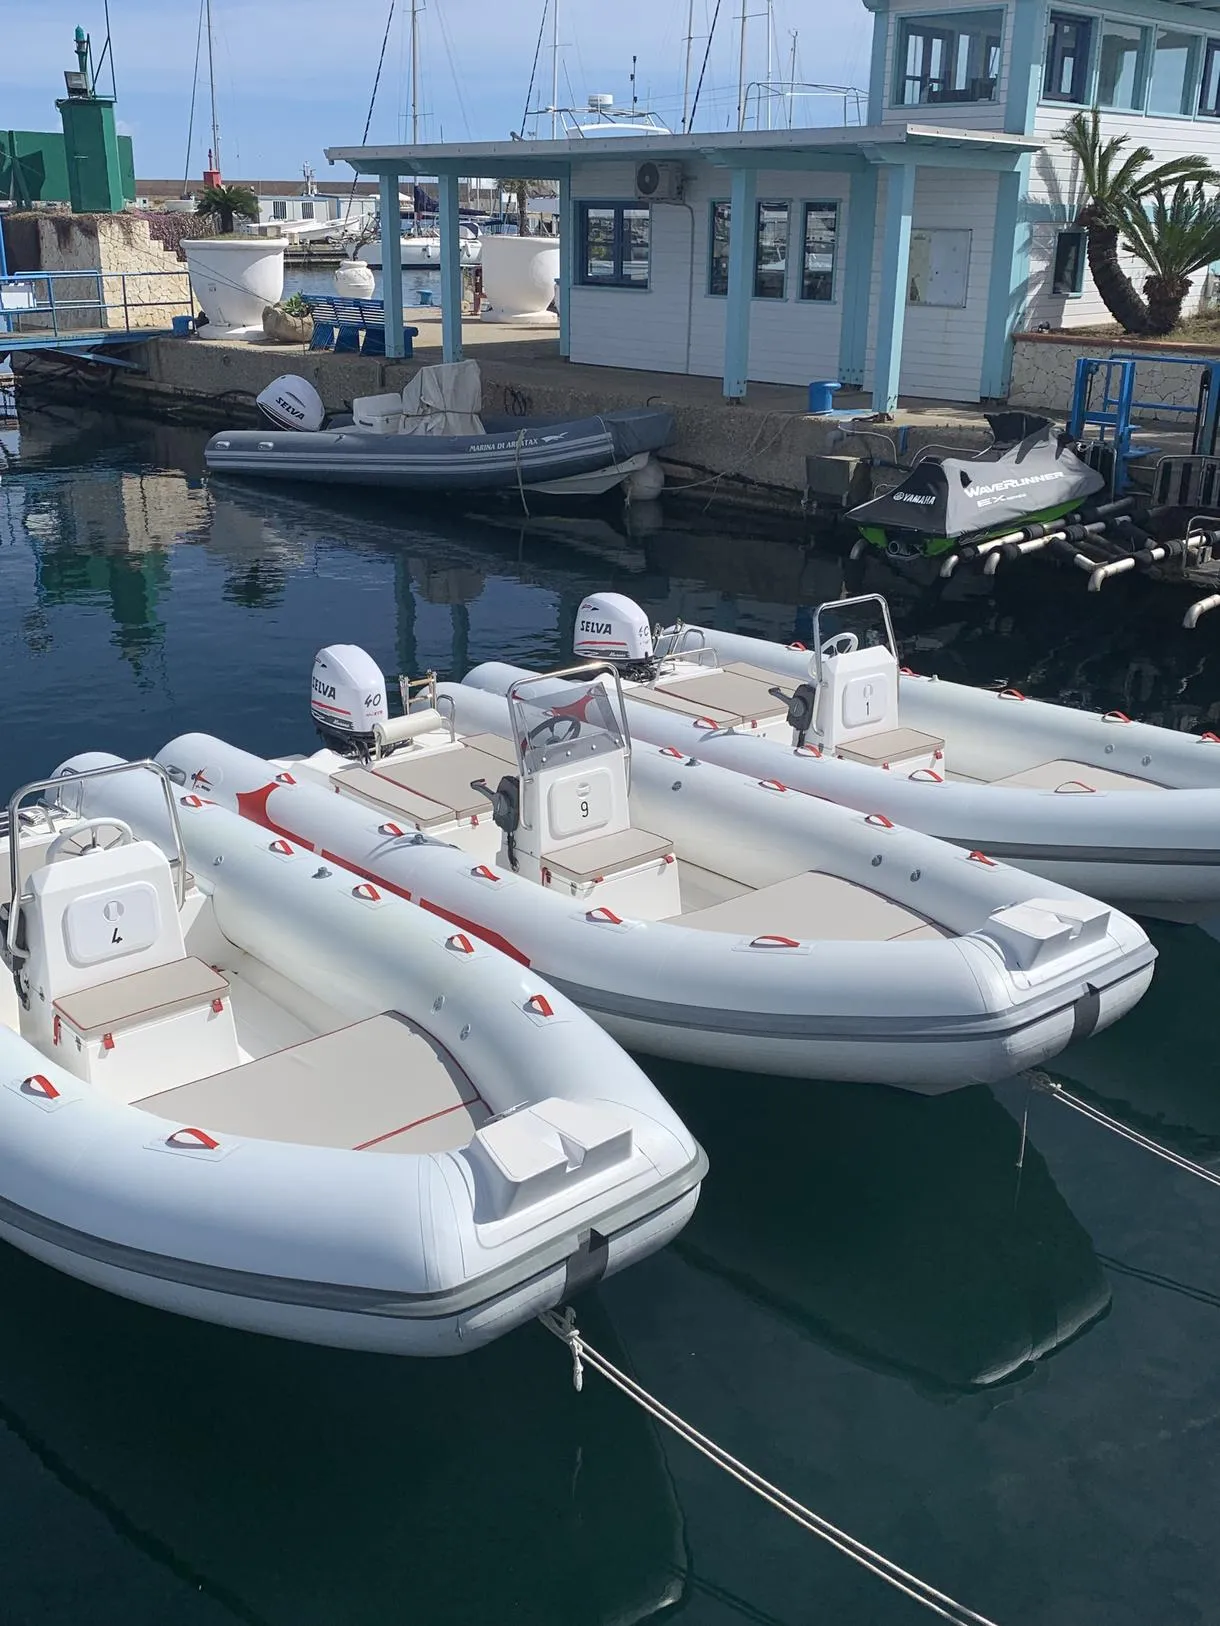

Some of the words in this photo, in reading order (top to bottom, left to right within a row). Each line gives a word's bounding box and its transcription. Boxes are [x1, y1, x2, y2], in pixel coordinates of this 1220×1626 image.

[275, 397, 305, 420] SELVA
[469, 443, 495, 452] MARINA
[903, 493, 936, 505] YAMAHA
[976, 494, 1006, 508] EX
[580, 620, 612, 635] SELVA
[364, 693, 381, 708] 40
[866, 701, 870, 716] 1
[580, 801, 589, 818] 9
[111, 927, 123, 944] 4
